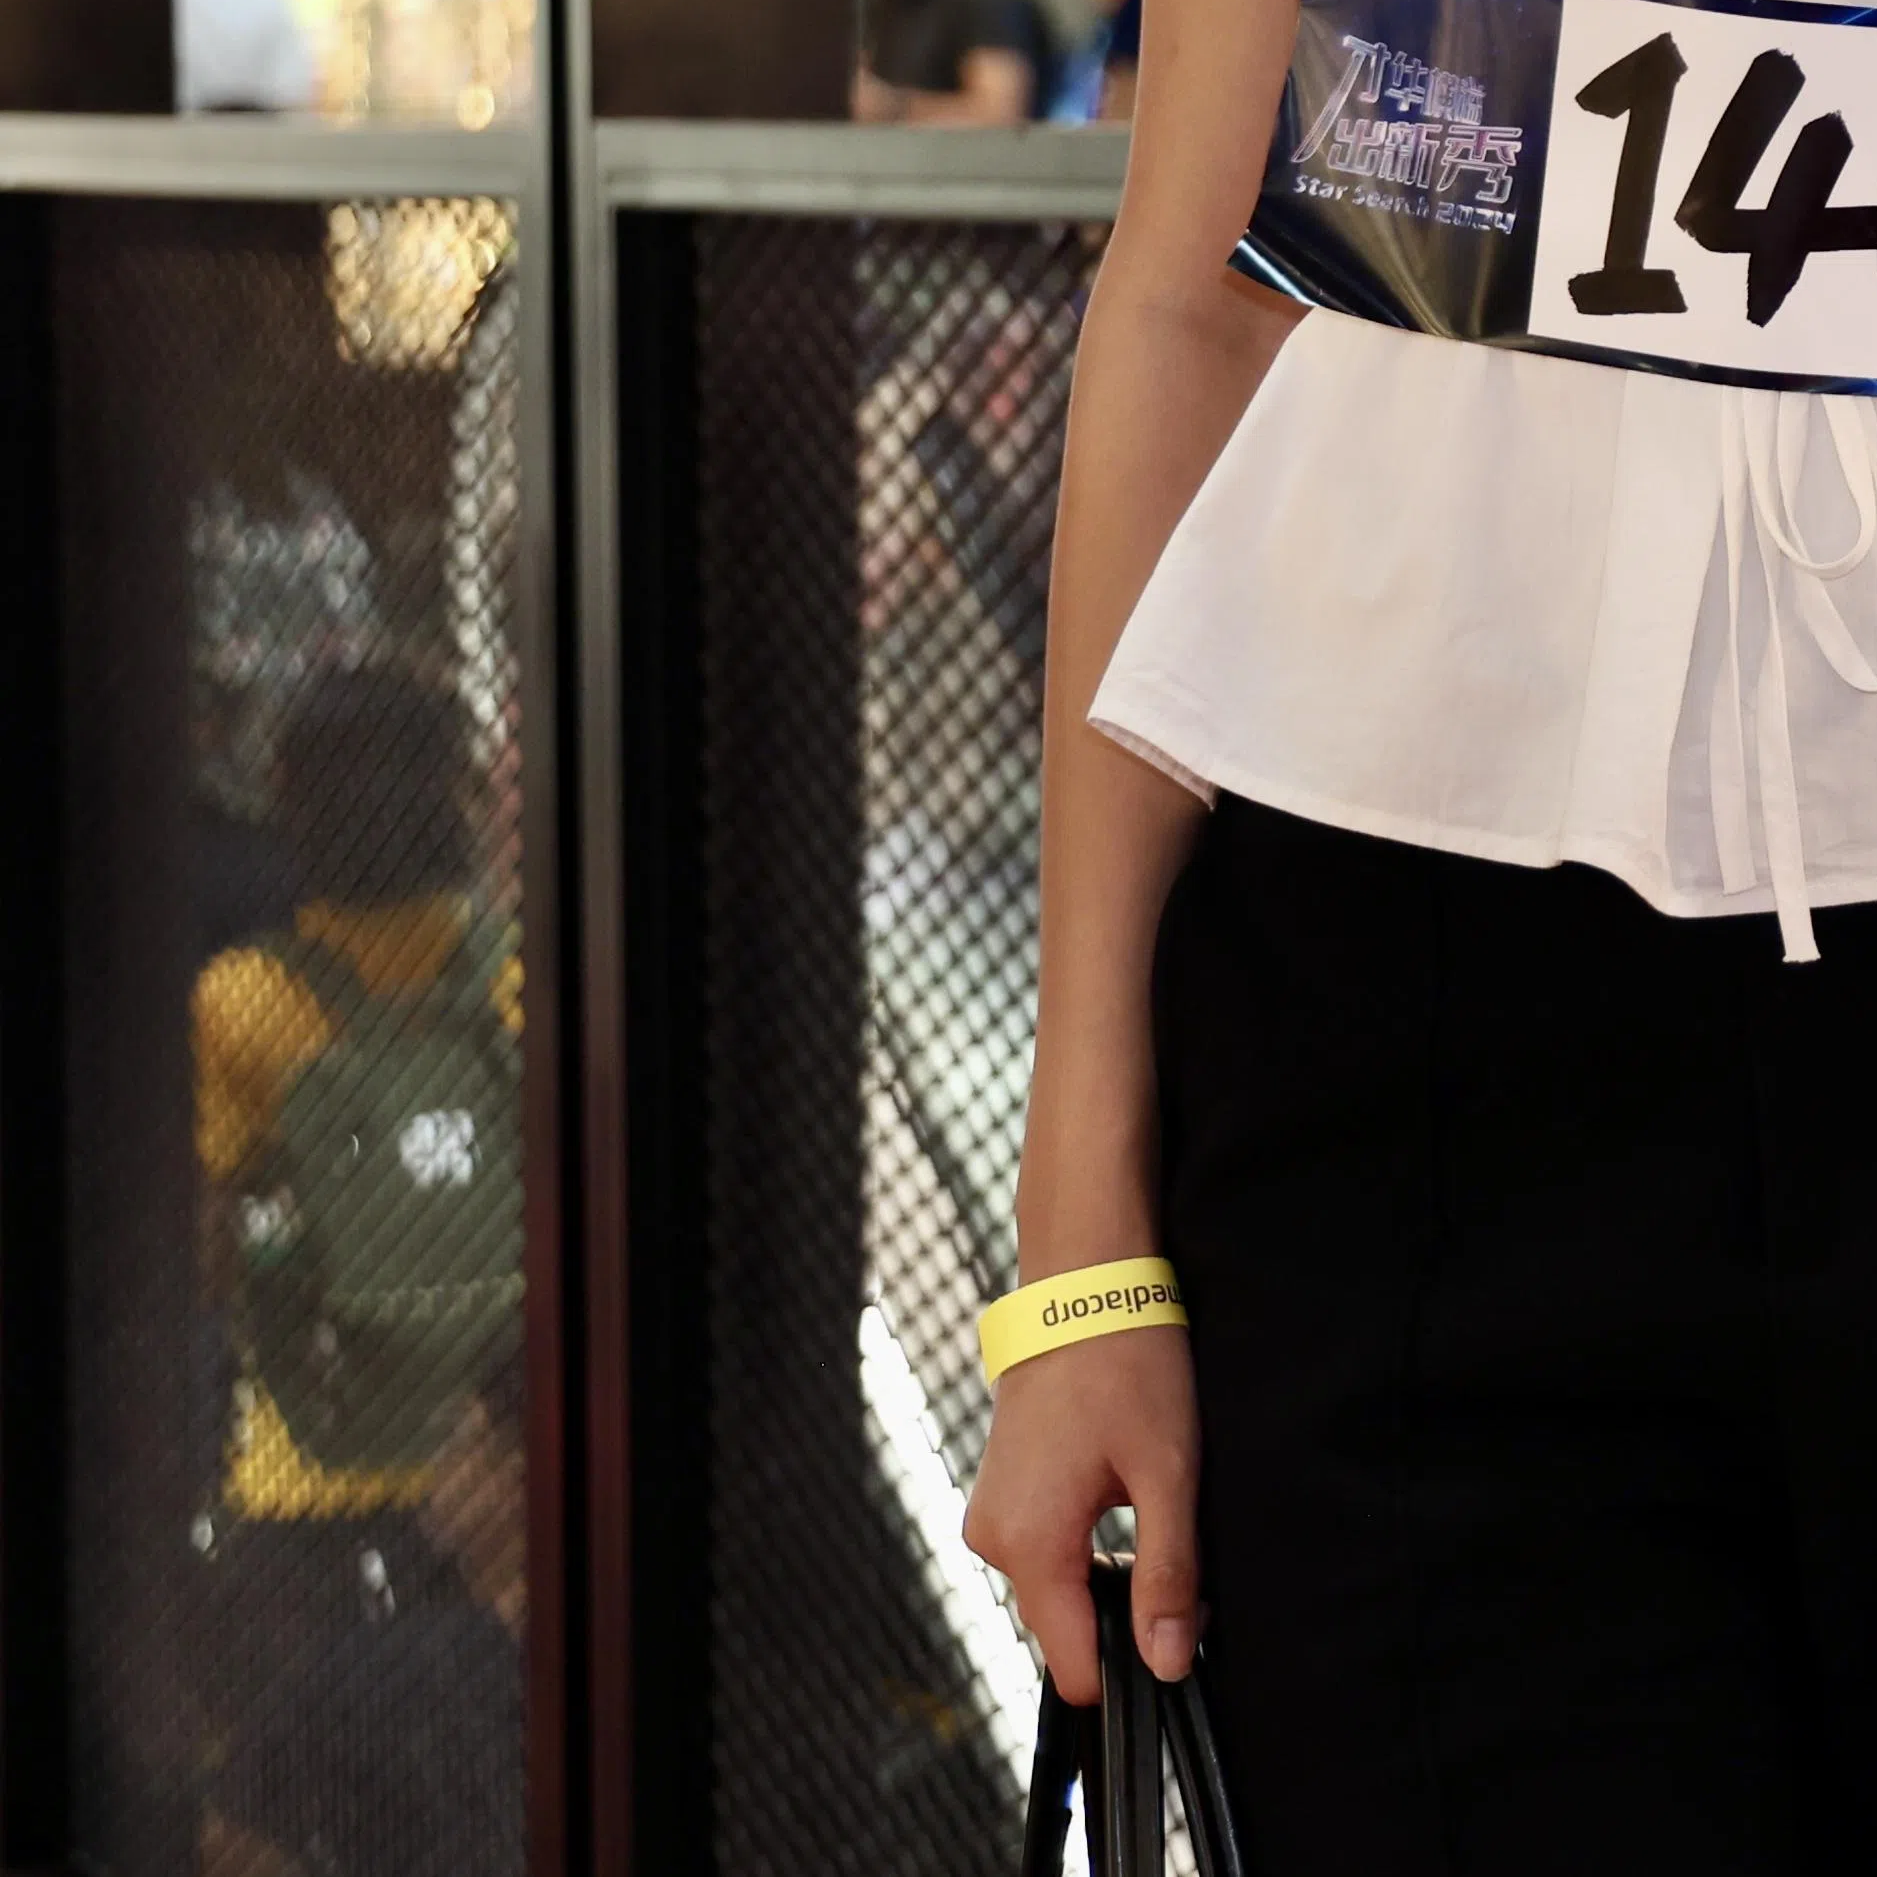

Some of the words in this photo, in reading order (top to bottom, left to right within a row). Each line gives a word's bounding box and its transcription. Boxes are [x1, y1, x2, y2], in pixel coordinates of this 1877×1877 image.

[1293, 174, 1349, 201] Star
[1327, 119, 1523, 203] 出新秀
